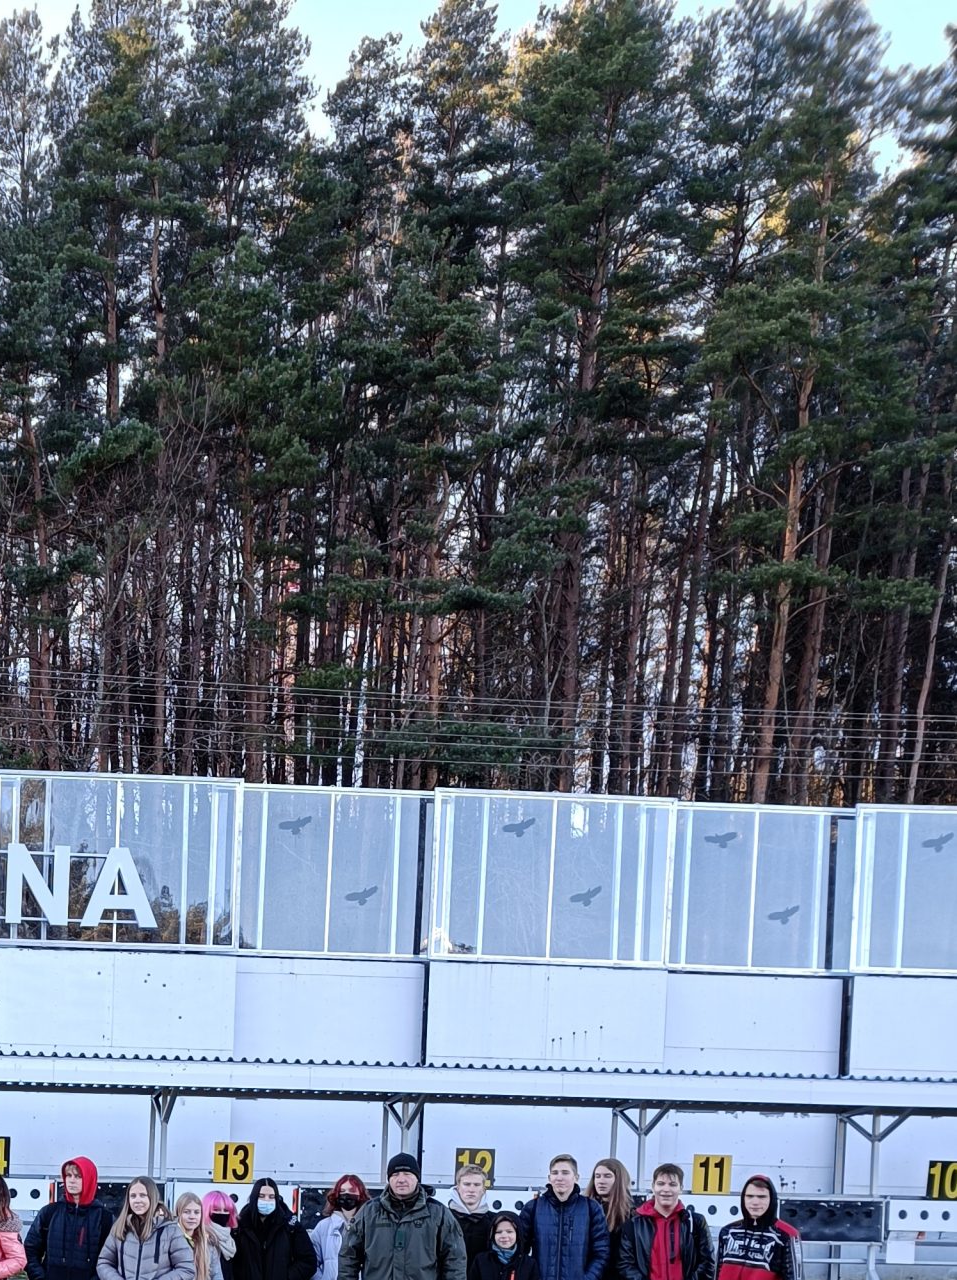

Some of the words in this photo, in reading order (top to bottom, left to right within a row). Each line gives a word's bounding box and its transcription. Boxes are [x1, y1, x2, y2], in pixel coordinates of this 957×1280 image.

[218, 1144, 249, 1180] 13
[699, 1156, 725, 1192] 11
[930, 1162, 957, 1199] 10
